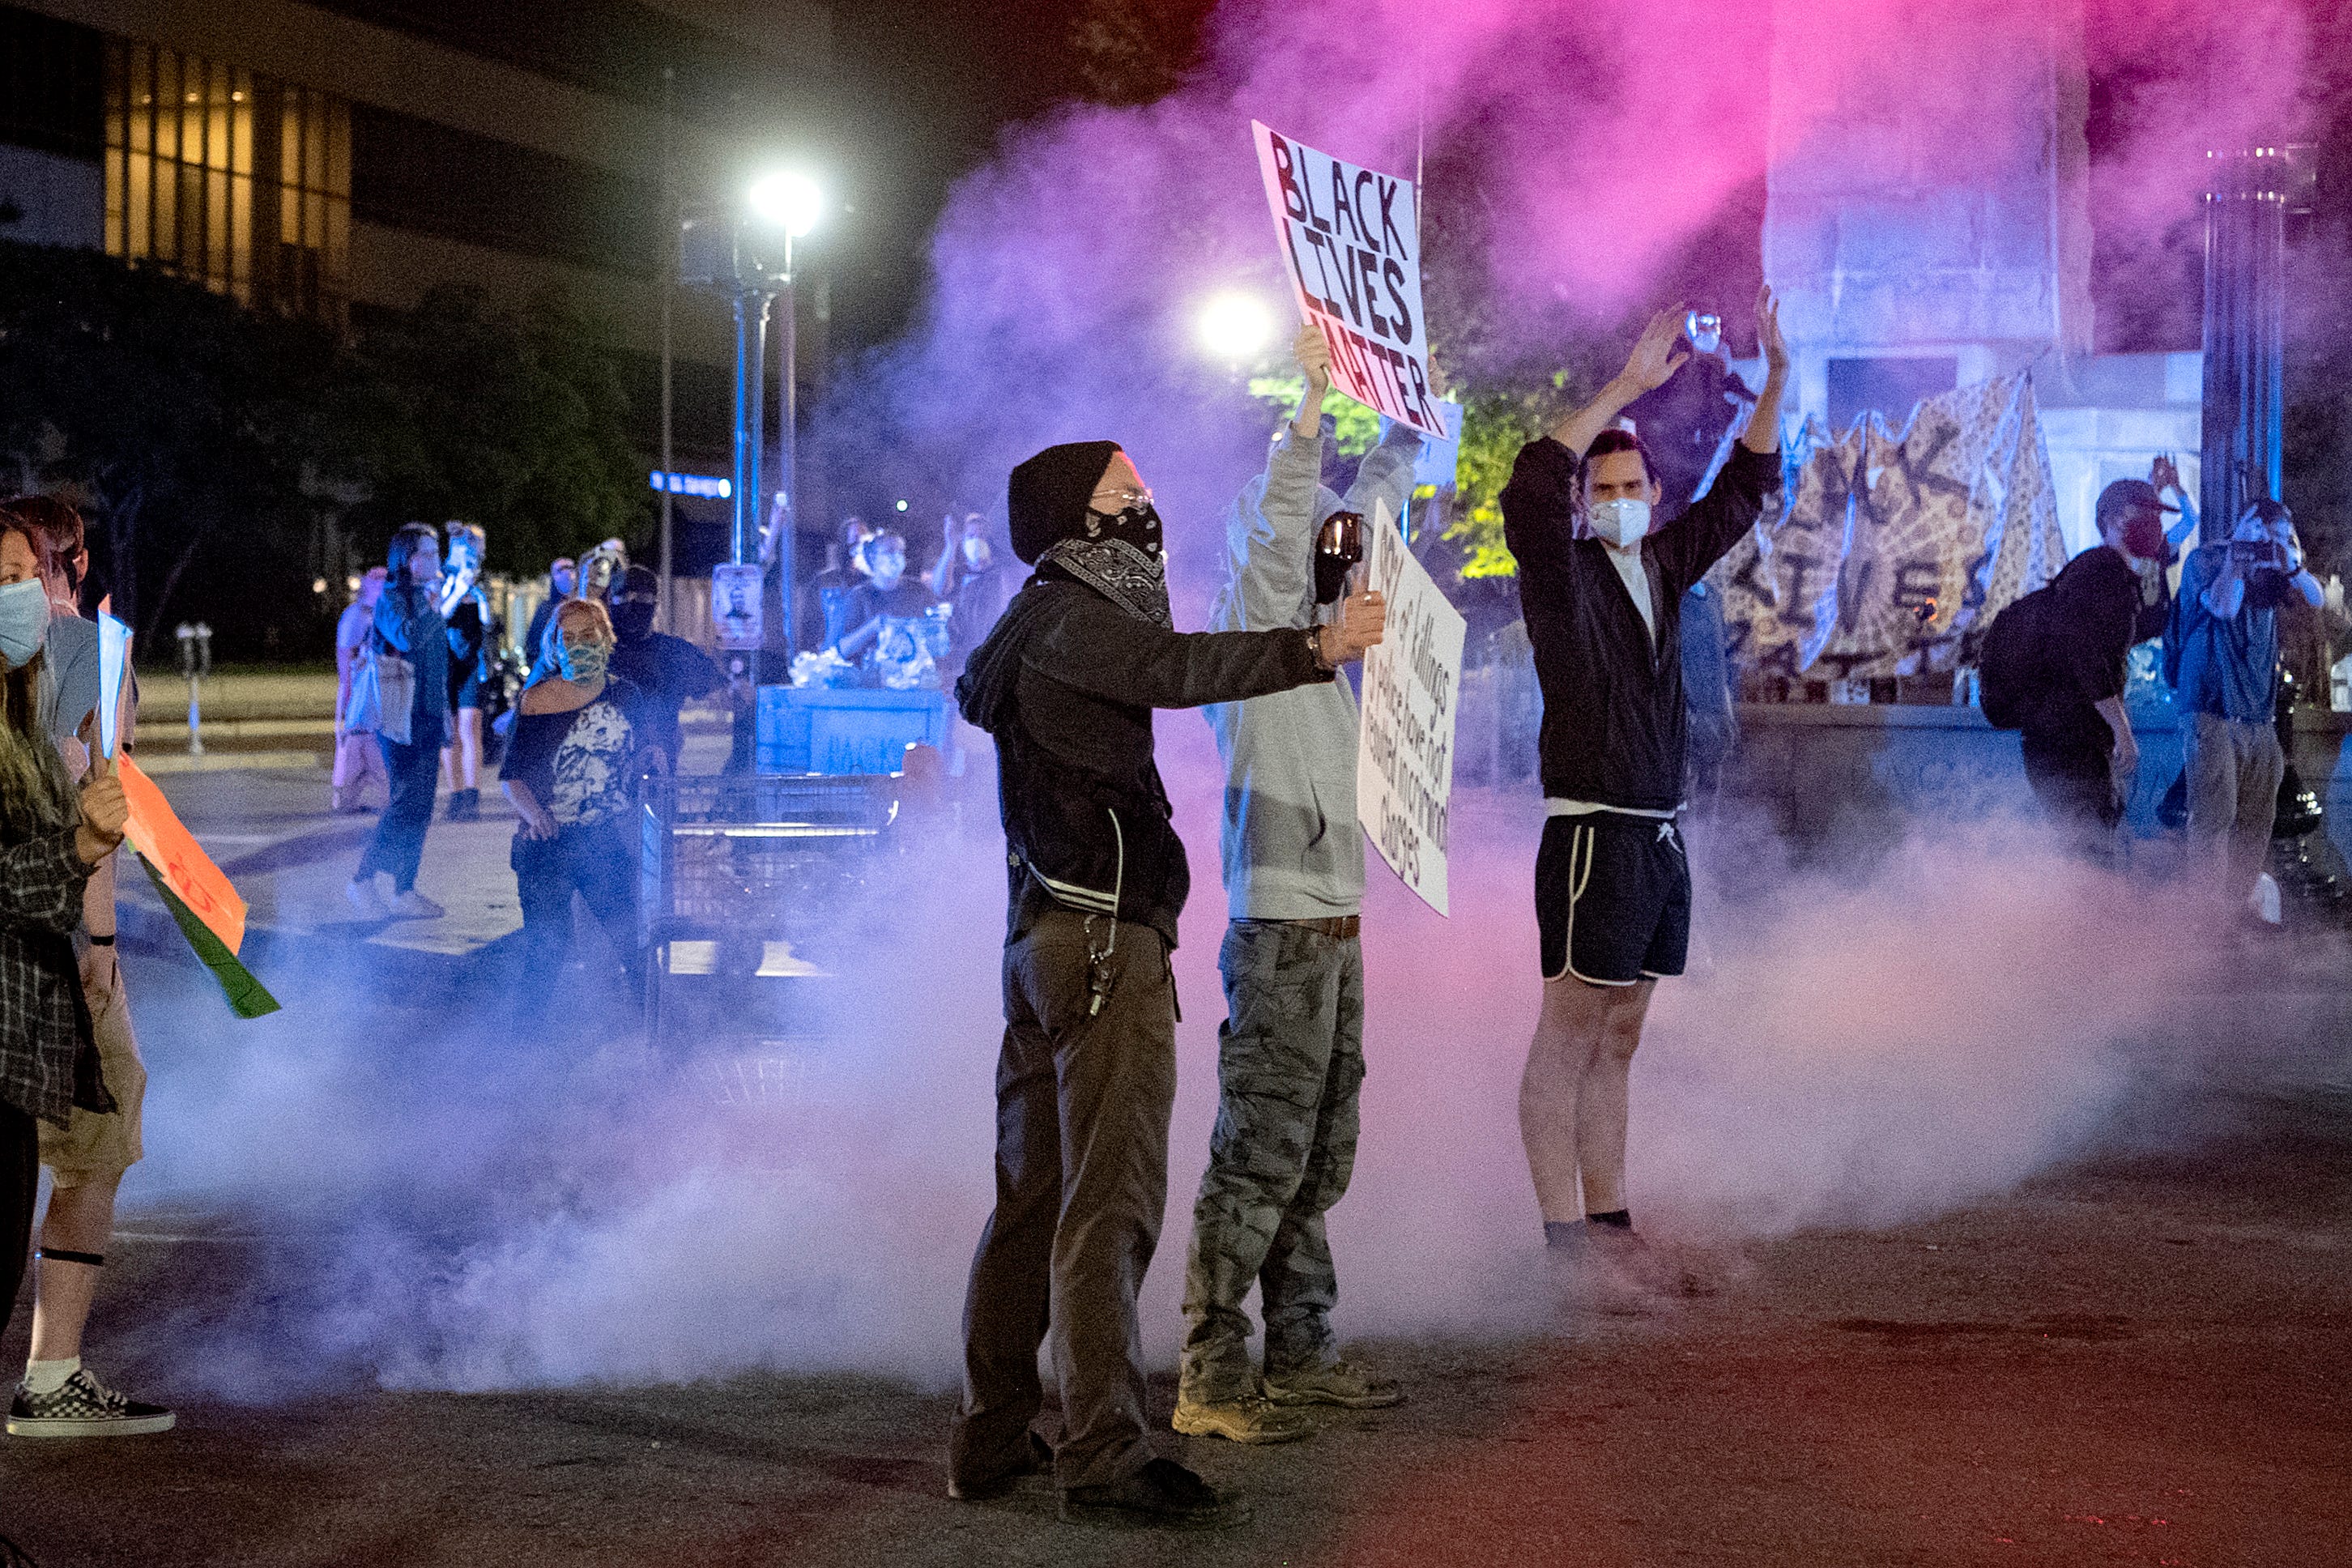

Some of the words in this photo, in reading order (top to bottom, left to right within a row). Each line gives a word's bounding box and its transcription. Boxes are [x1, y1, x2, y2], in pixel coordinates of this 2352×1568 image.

[1270, 131, 1408, 261] BLACK
[1282, 217, 1412, 346] LIVES
[1310, 311, 1444, 437] MATTER
[1377, 649, 1402, 727] police
[1403, 679, 1425, 762] have
[1426, 731, 1447, 795] not
[1400, 599, 1413, 658] of
[1409, 590, 1450, 732] killings
[1380, 789, 1420, 888] charges
